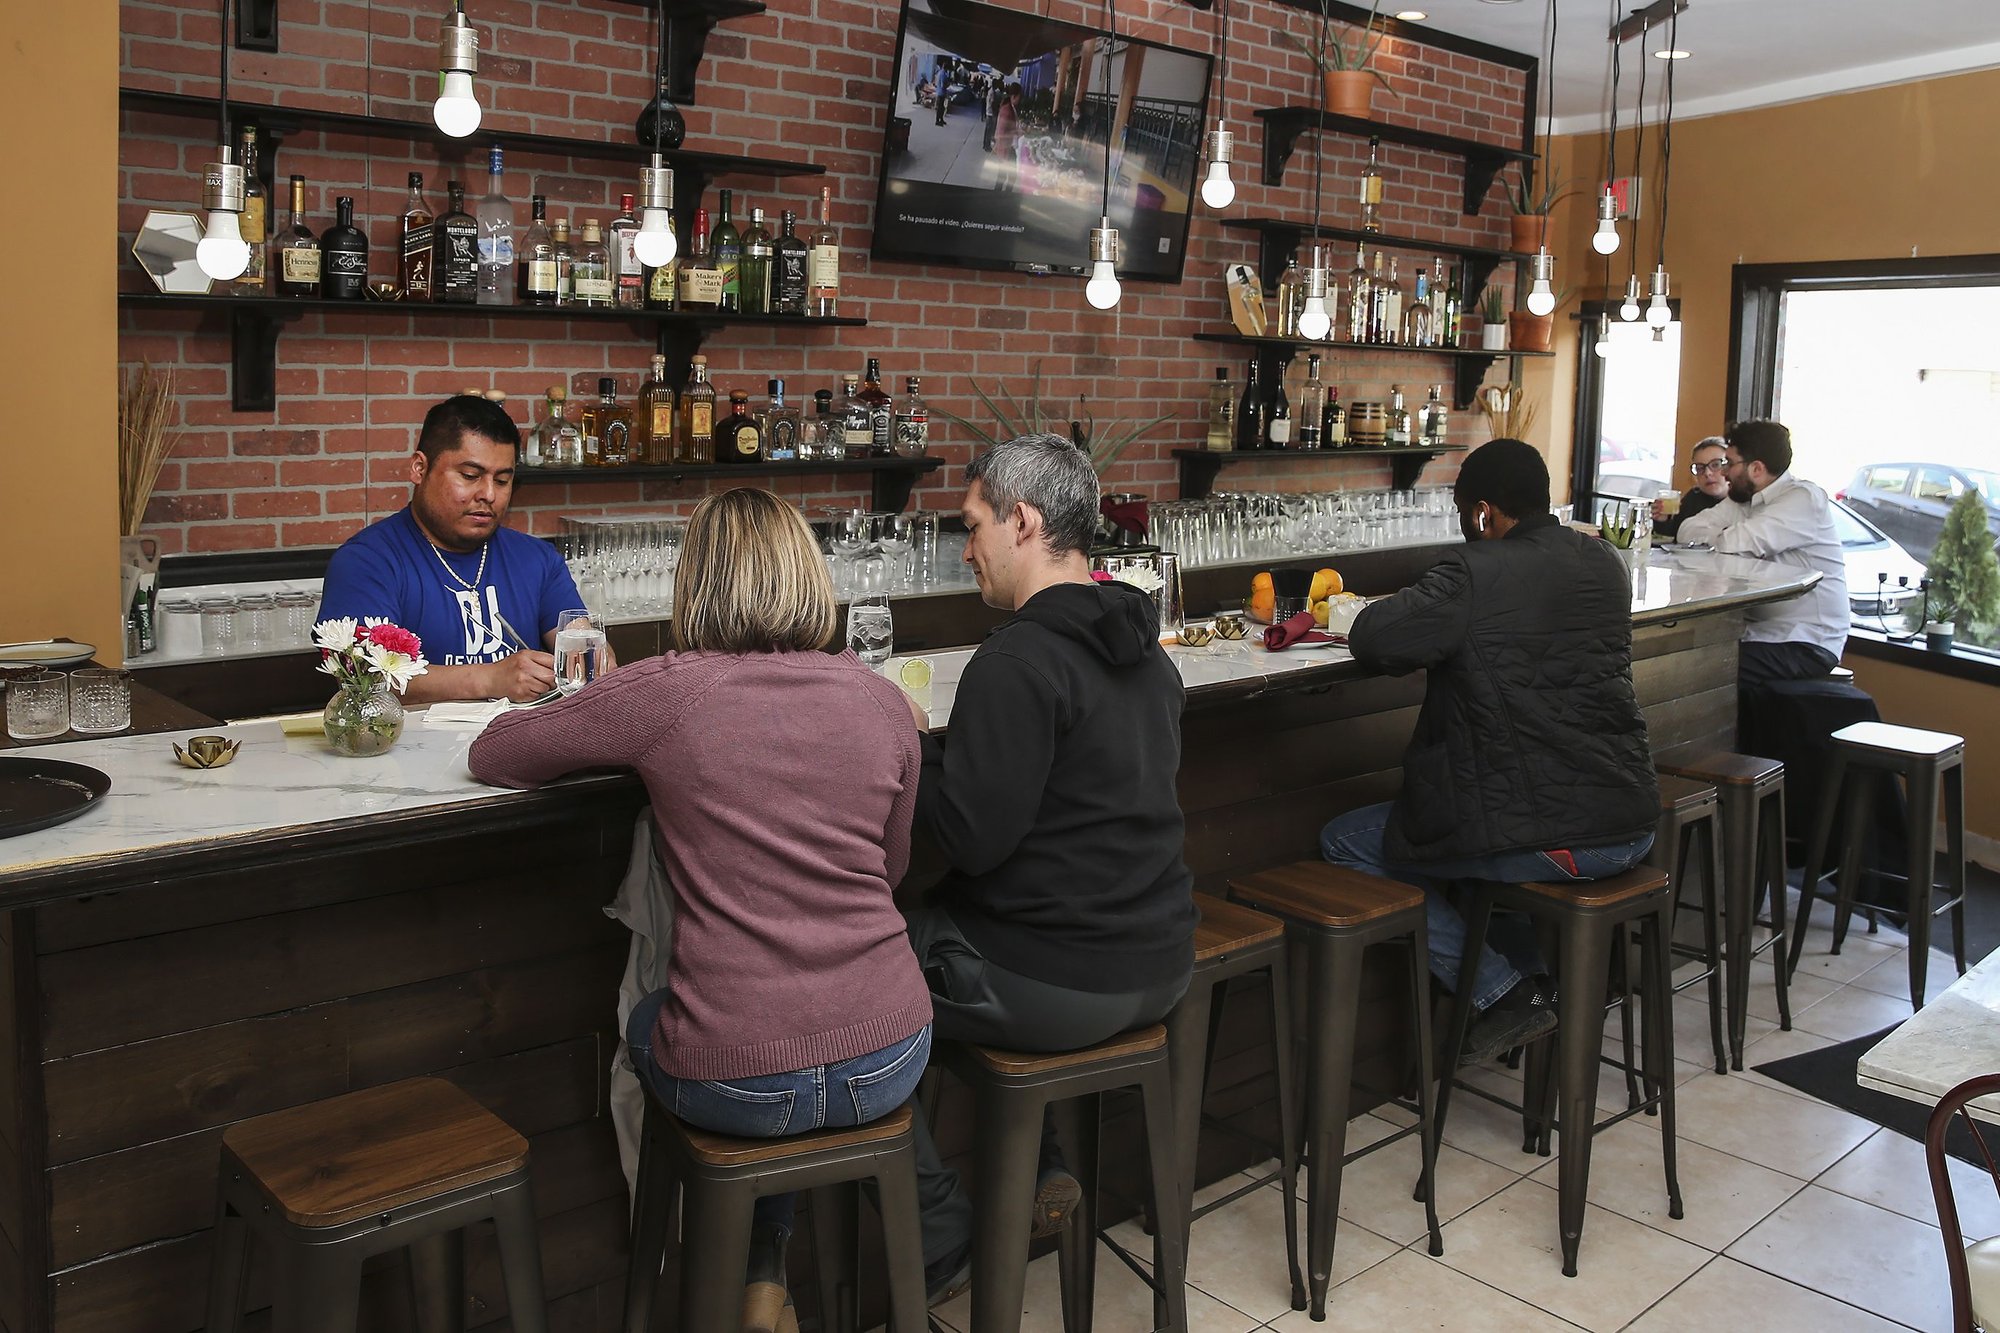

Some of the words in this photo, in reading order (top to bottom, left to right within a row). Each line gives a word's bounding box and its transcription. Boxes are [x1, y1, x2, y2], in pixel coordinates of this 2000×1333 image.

[899, 213, 907, 221] Se
[907, 214, 914, 222] ha
[915, 215, 938, 224] pausado
[938, 217, 944, 225] el
[961, 220, 984, 229] ¿Quieres
[984, 223, 1000, 231] seguir
[446, 226, 477, 235] MONTELOBOS
